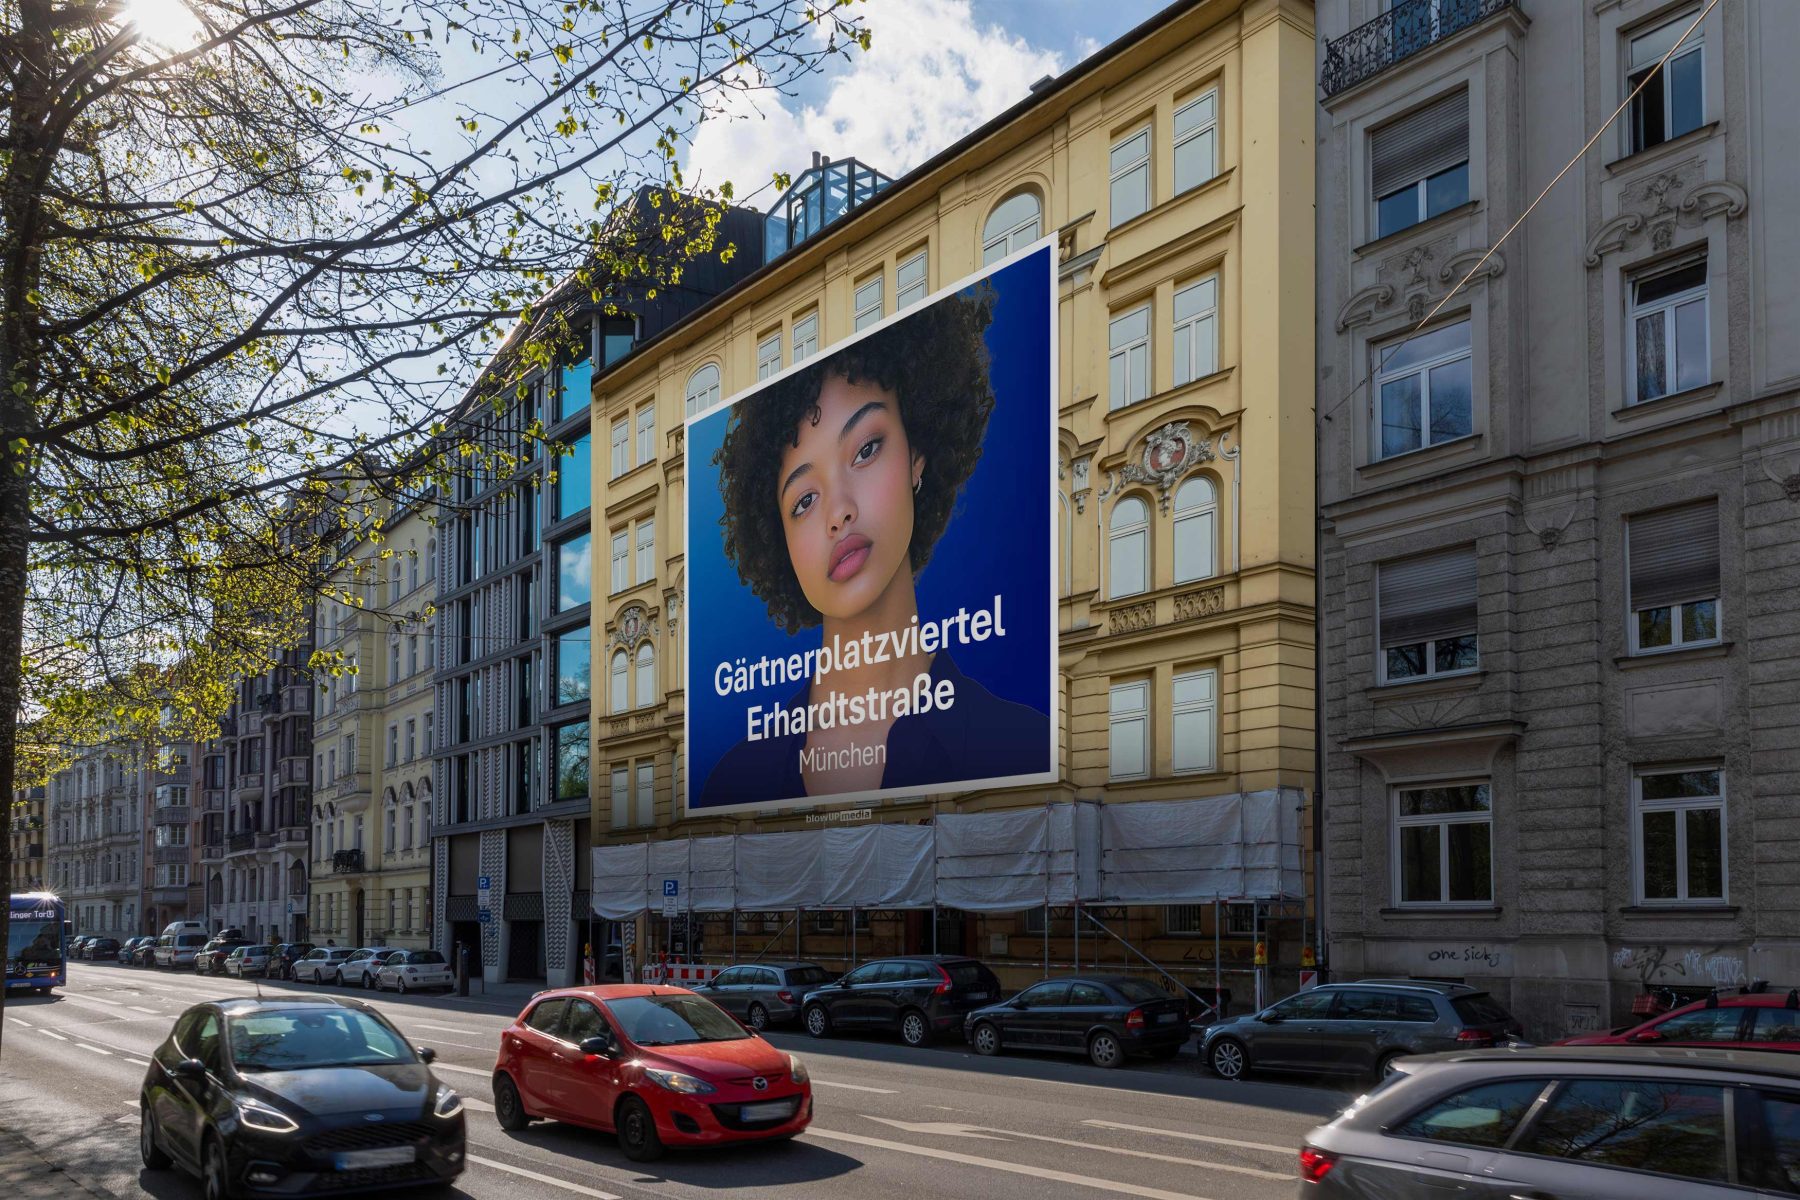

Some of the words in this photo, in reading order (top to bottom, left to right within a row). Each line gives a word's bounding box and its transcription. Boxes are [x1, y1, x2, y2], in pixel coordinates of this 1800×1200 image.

[714, 595, 1006, 697] Gärtnerplatzviertel
[747, 673, 955, 742] Erhardtstraße
[799, 742, 886, 774] München
[665, 881, 674, 894] P
